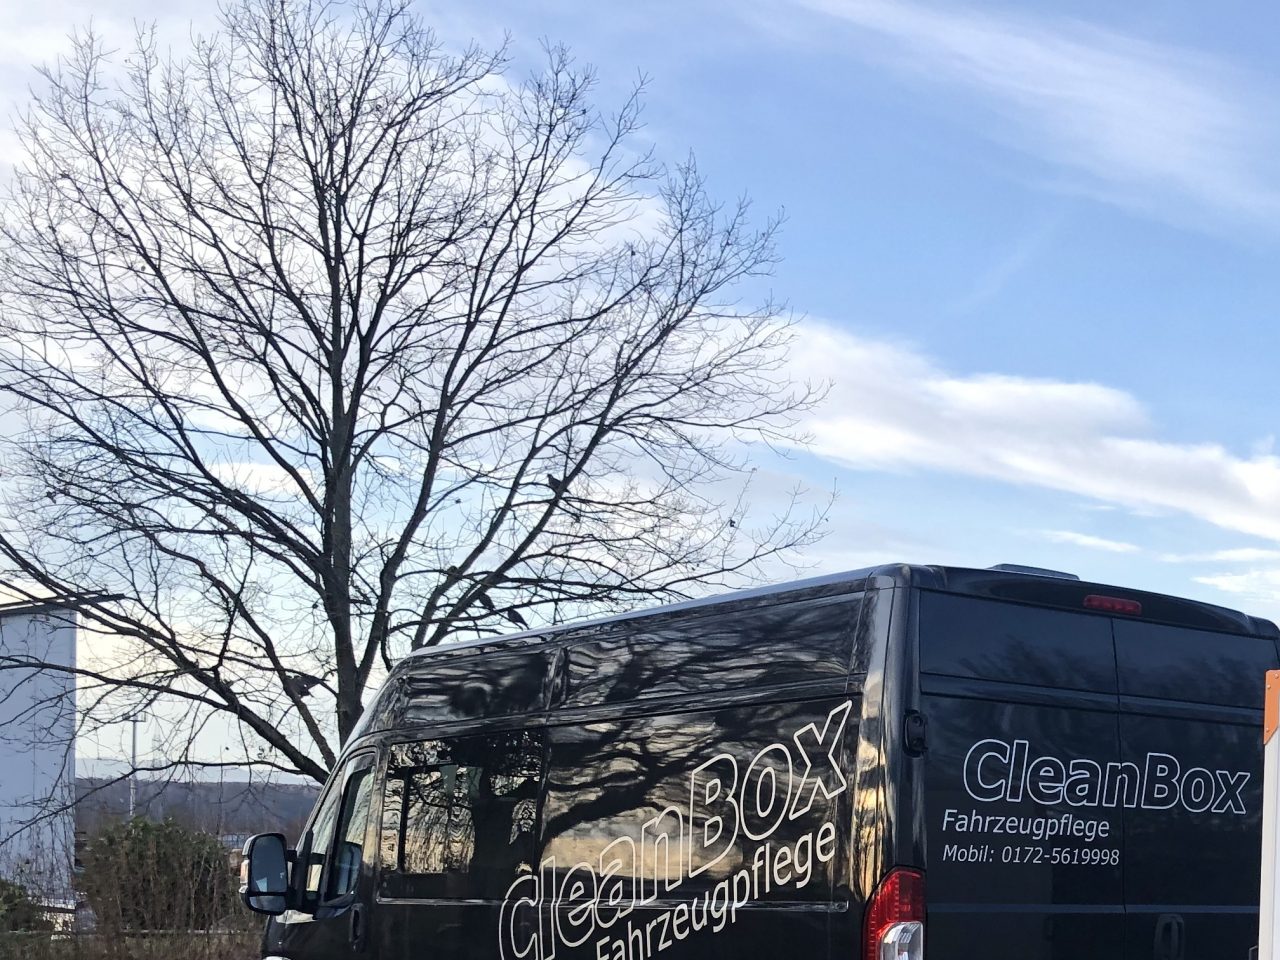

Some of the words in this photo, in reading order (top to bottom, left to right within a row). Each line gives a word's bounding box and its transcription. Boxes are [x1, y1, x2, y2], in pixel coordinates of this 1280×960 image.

[963, 738, 1250, 814] CleanBox
[942, 809, 1110, 842] Fahrzeugpflege
[942, 844, 995, 863] Mobil:
[1001, 846, 1120, 866] 0172-5619998
